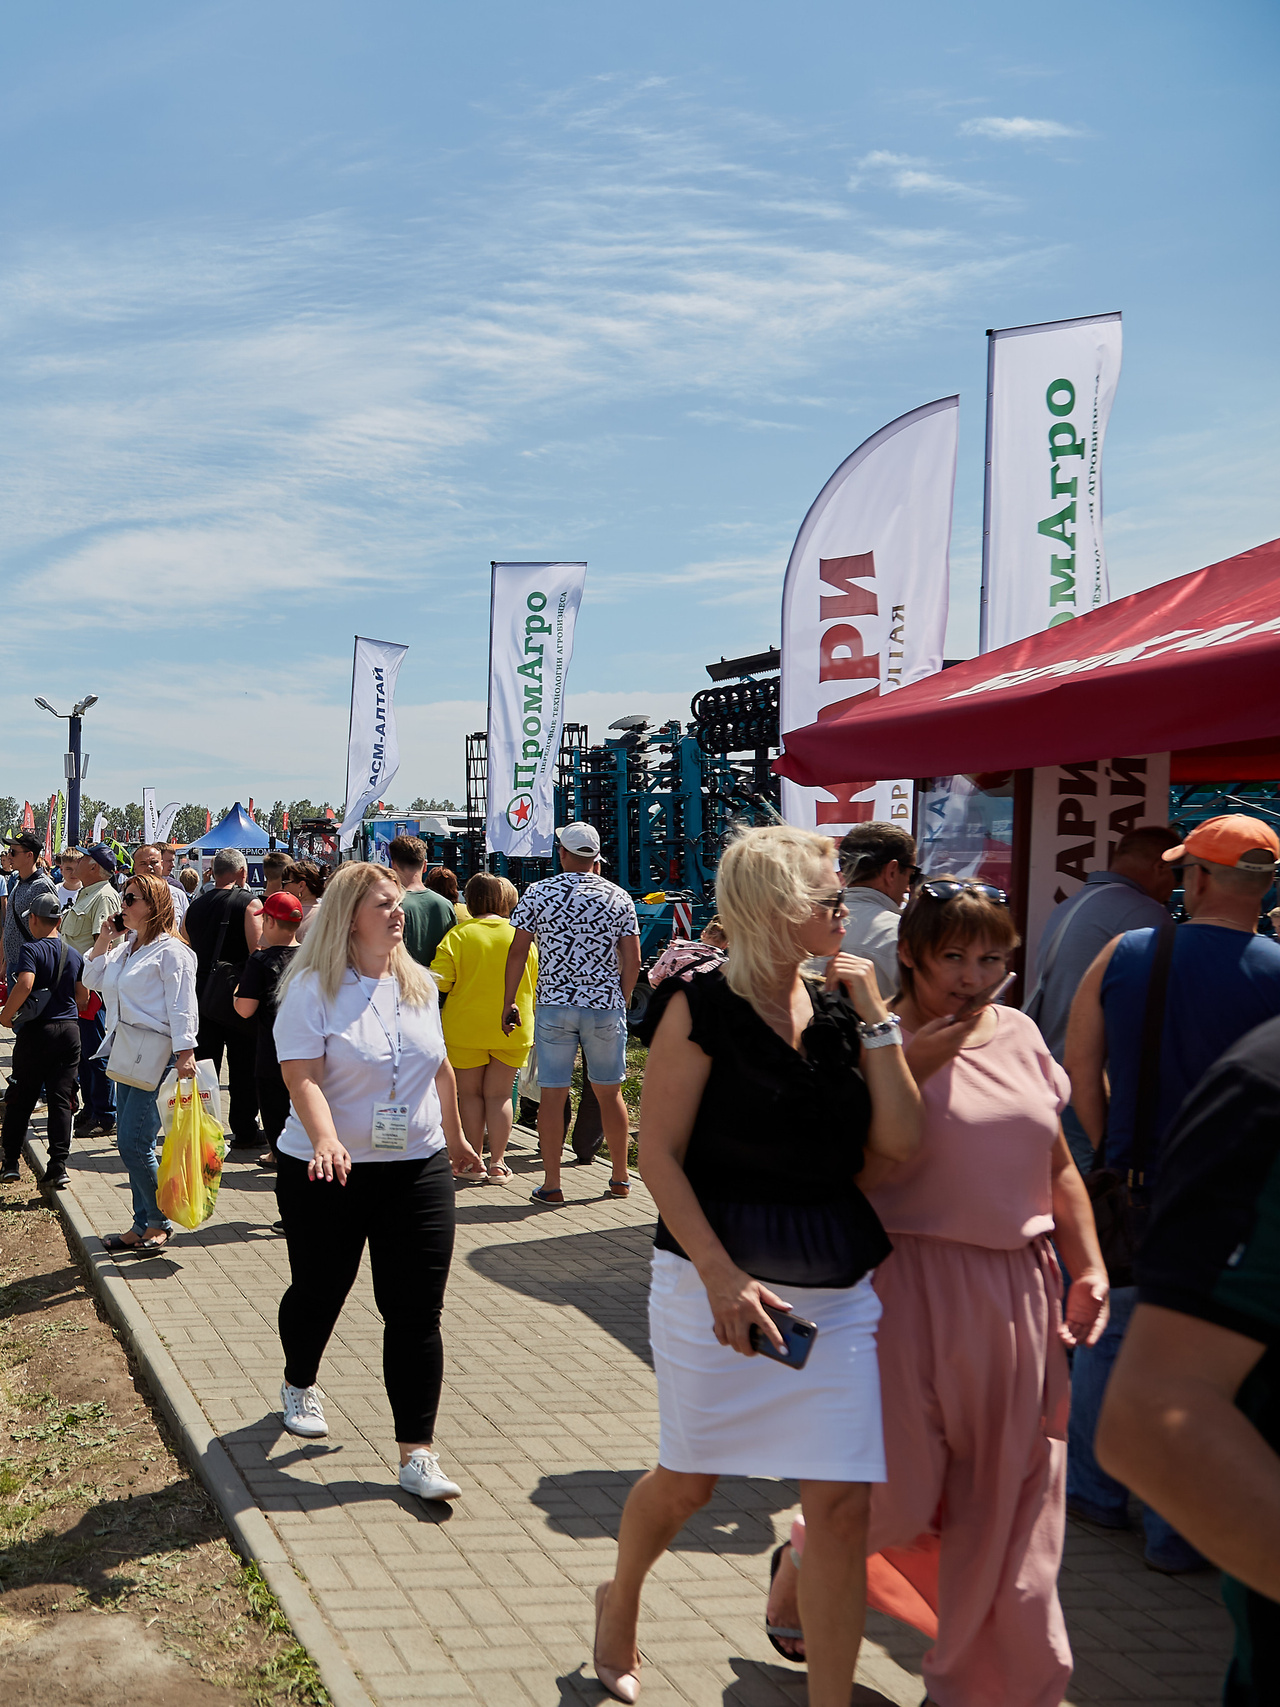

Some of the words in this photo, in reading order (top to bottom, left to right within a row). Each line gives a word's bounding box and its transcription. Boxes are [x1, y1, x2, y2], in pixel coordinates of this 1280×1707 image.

[1037, 378, 1086, 628] мАгро
[369, 666, 384, 787] АСМ-АЛТАЙ
[513, 591, 552, 791] ПромАгро
[540, 718, 558, 774] ПЕРЕДОВЫЕ
[551, 657, 563, 717] ТЕХНОЛОГИИ
[557, 590, 568, 655] АГРОБИЗНЕСА
[887, 604, 905, 686] ЛТАЯ
[1054, 760, 1100, 905] АРИ
